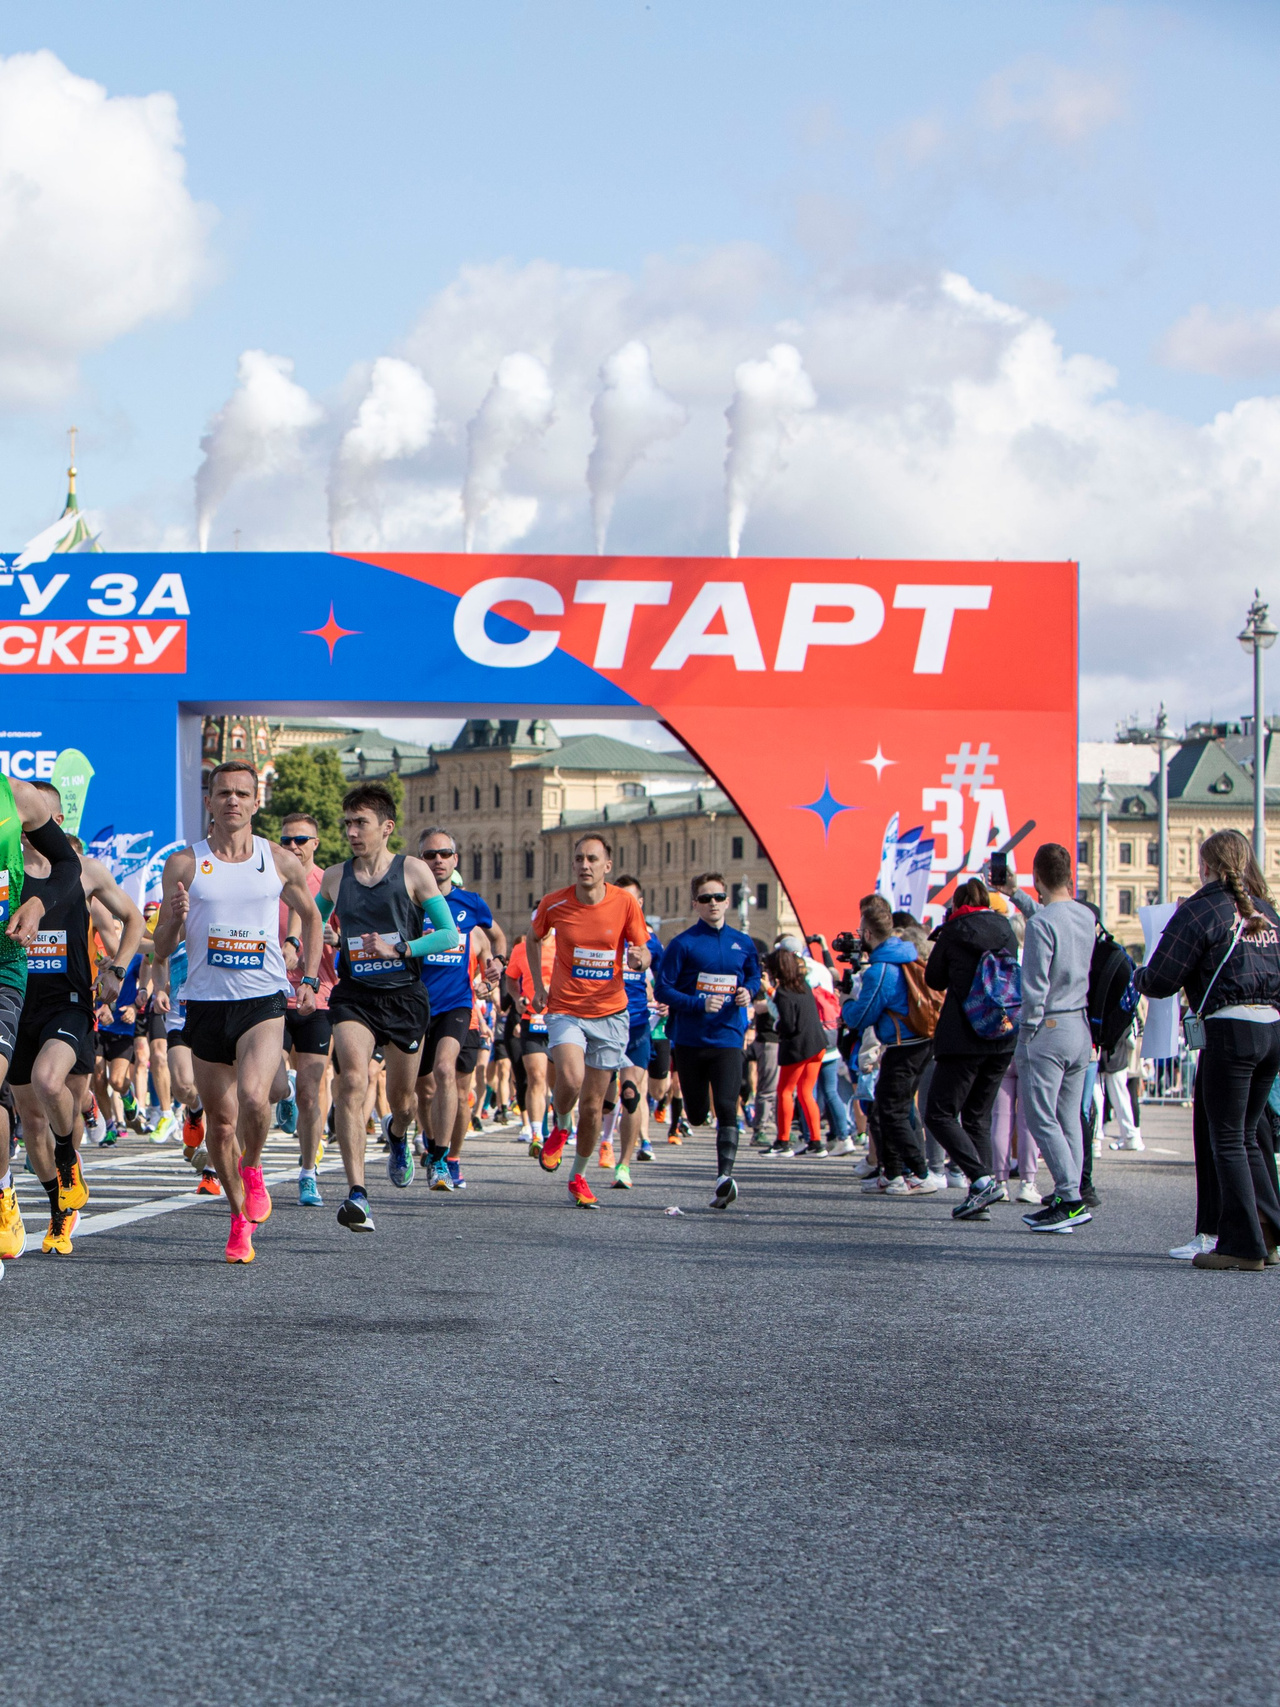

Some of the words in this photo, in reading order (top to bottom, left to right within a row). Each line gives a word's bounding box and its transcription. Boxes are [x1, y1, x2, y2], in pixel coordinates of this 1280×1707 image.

[87, 573, 191, 616] ЗА
[453, 576, 993, 675] СТАРТ
[61, 776, 70, 787] 21
[922, 787, 1016, 872] ЗА
[26, 946, 57, 955] 1,1КМ
[27, 959, 62, 969] 2316
[213, 953, 260, 965] 03149
[427, 954, 462, 963] 02277
[354, 959, 403, 973] 02606
[576, 968, 610, 978] 01794
